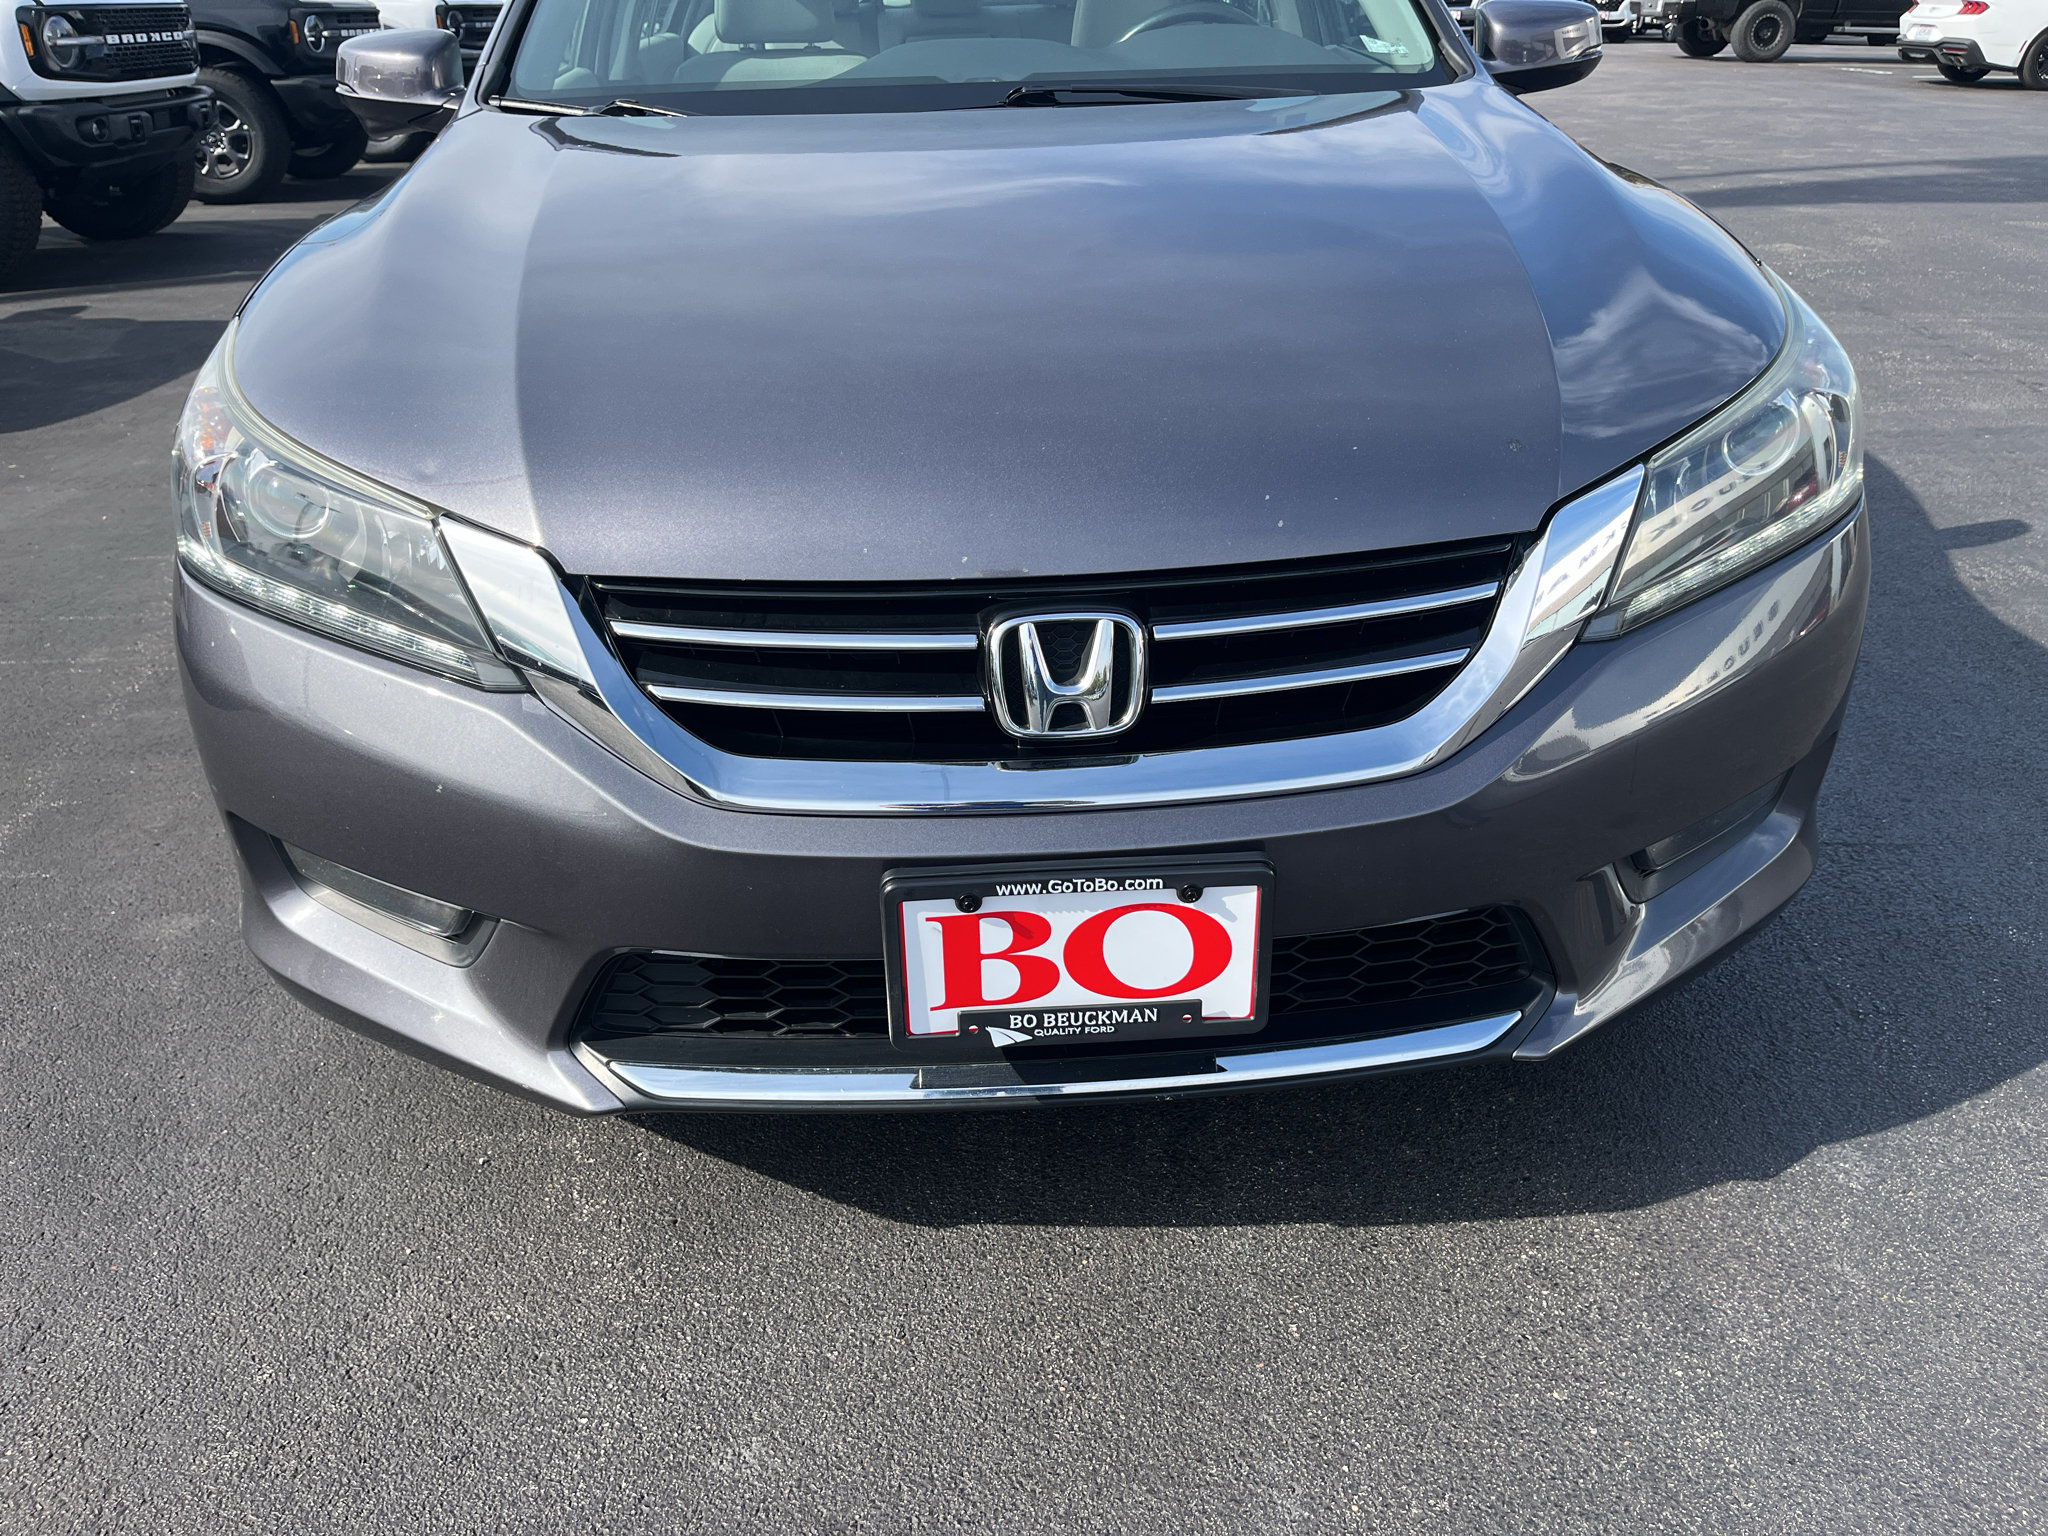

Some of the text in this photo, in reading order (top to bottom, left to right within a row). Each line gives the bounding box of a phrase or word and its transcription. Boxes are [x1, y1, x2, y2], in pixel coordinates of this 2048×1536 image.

[105, 31, 184, 45] BRONCO
[995, 877, 1164, 896] www.GoToBo.com
[925, 903, 1233, 1012] BO
[1009, 1008, 1158, 1029] BO BEUCKMAN
[1034, 1025, 1115, 1037] QUALITY FORD
